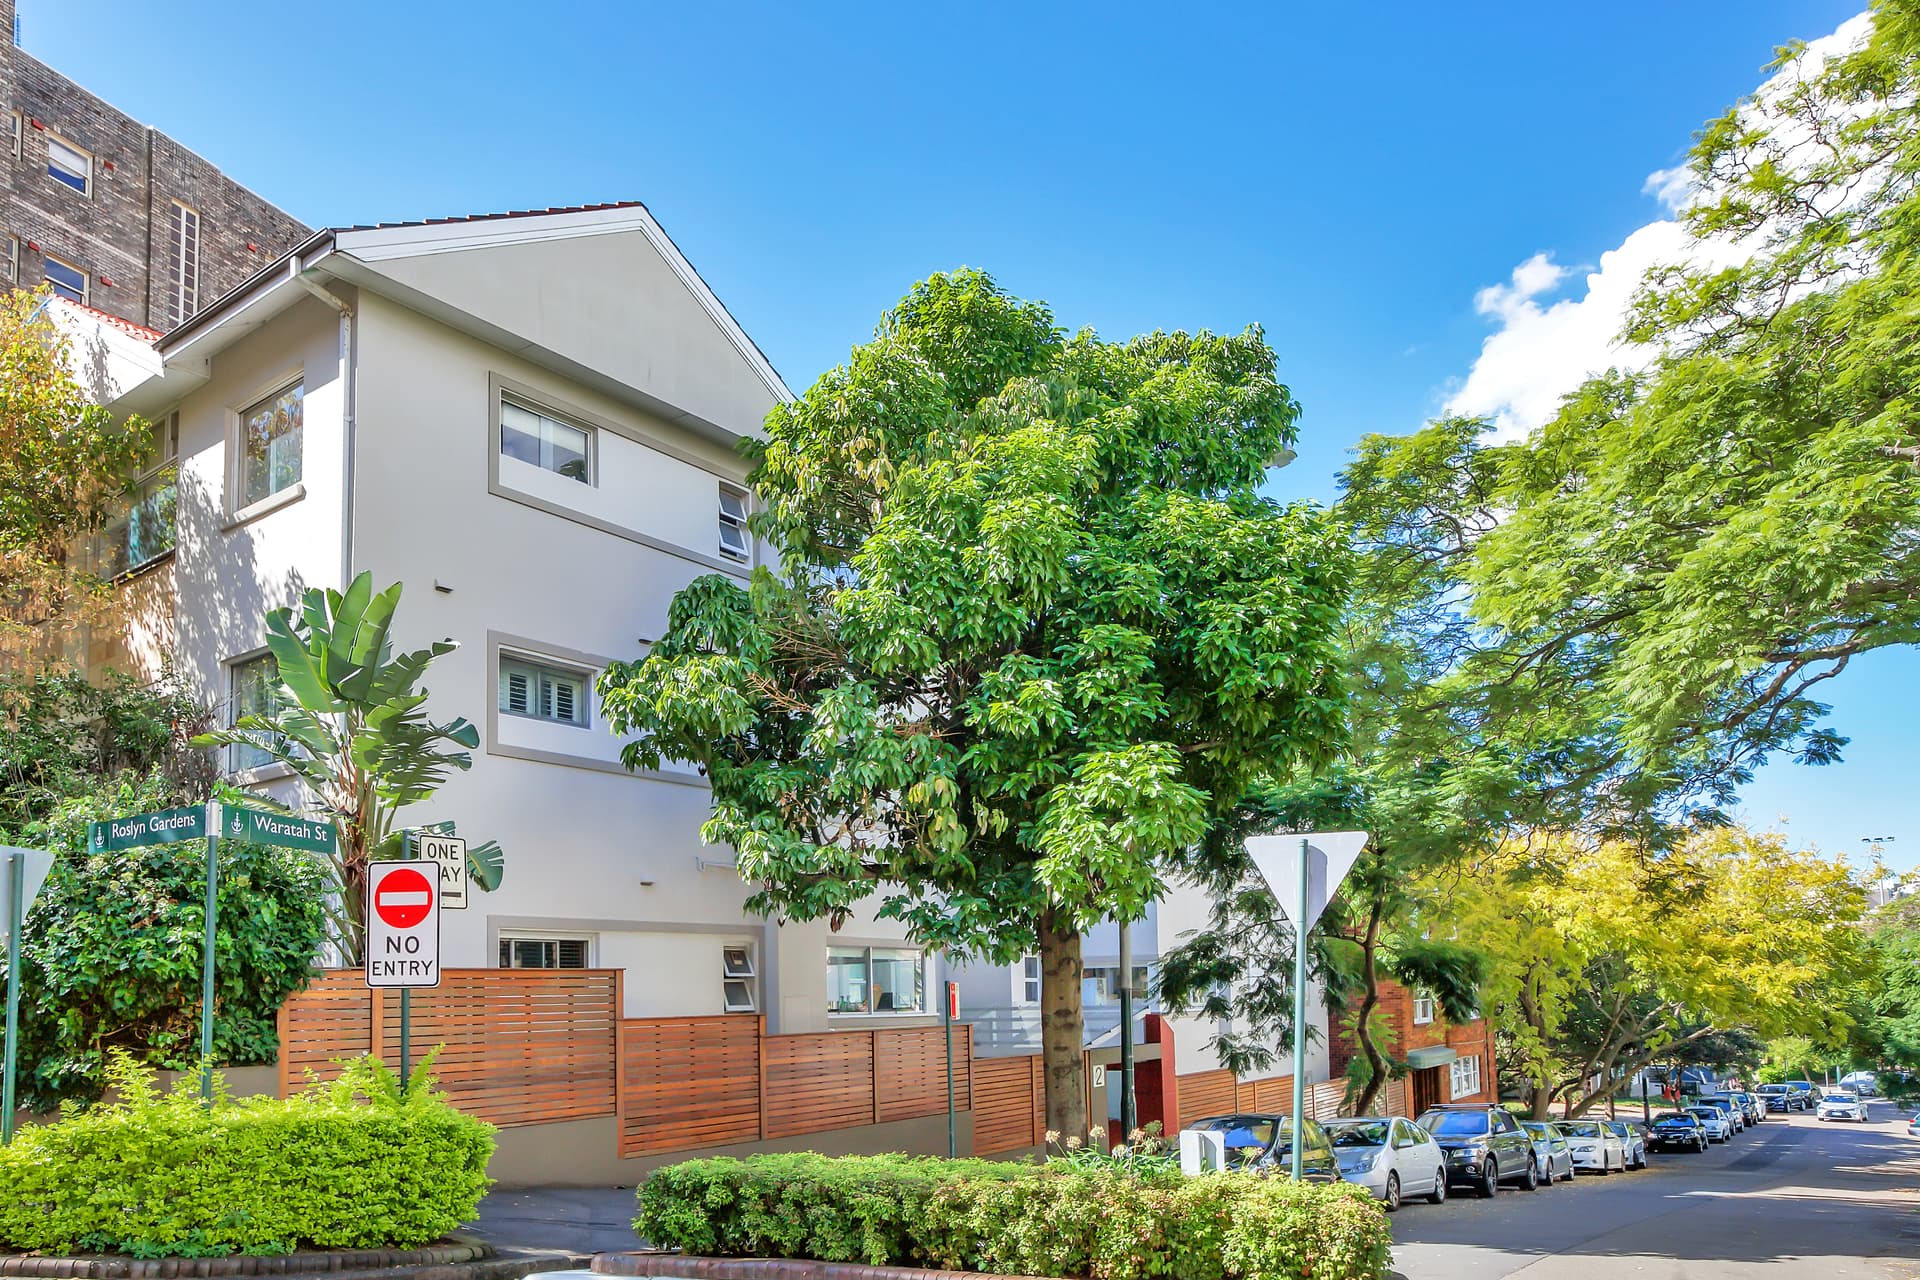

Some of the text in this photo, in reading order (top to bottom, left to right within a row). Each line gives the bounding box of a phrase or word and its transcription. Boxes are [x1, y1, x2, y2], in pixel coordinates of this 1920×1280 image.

[112, 813, 196, 840] Roslyn Gardens
[254, 814, 328, 841] Waratah St
[427, 842, 459, 860] ONE
[440, 866, 461, 882] AY
[386, 935, 420, 954] NO
[372, 960, 433, 977] ENTRY
[1095, 1066, 1103, 1085] 2
